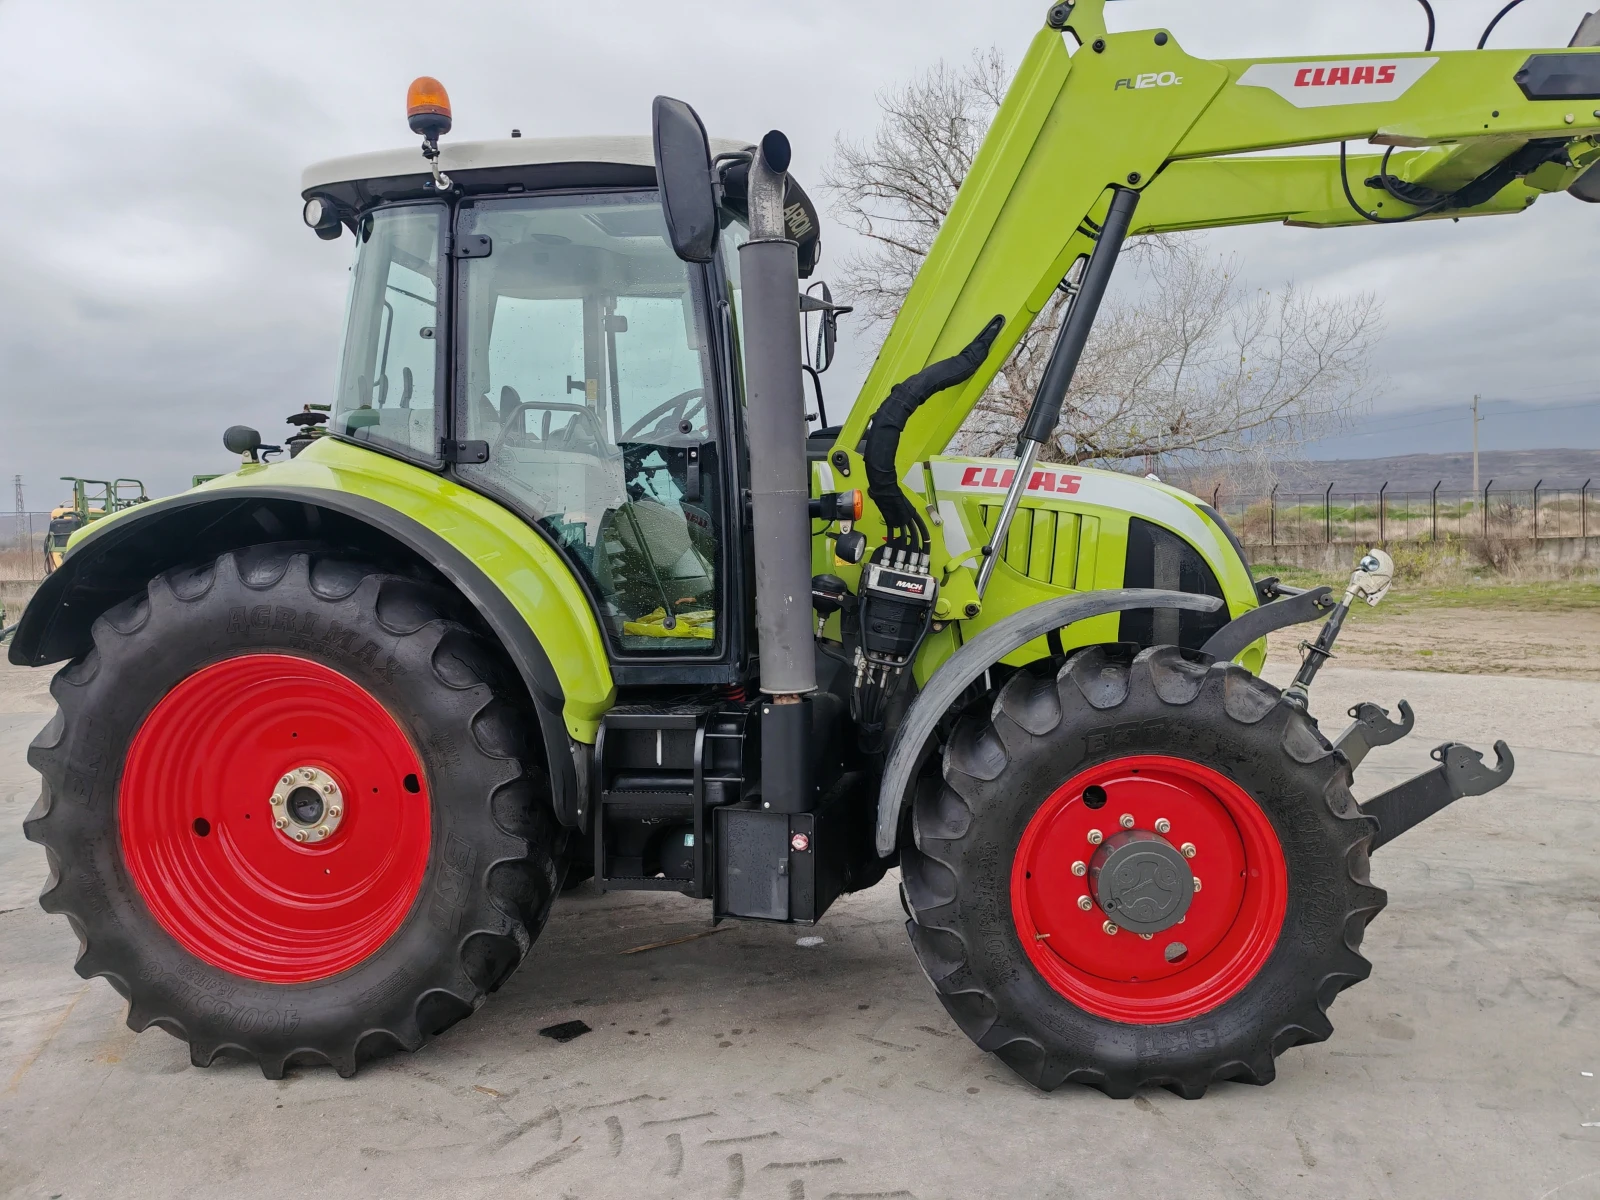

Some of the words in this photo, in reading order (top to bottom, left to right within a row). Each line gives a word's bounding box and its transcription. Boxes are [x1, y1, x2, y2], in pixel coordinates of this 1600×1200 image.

[1294, 65, 1397, 87] CLAAS
[783, 202, 813, 239] ARION
[895, 580, 923, 591] MACH
